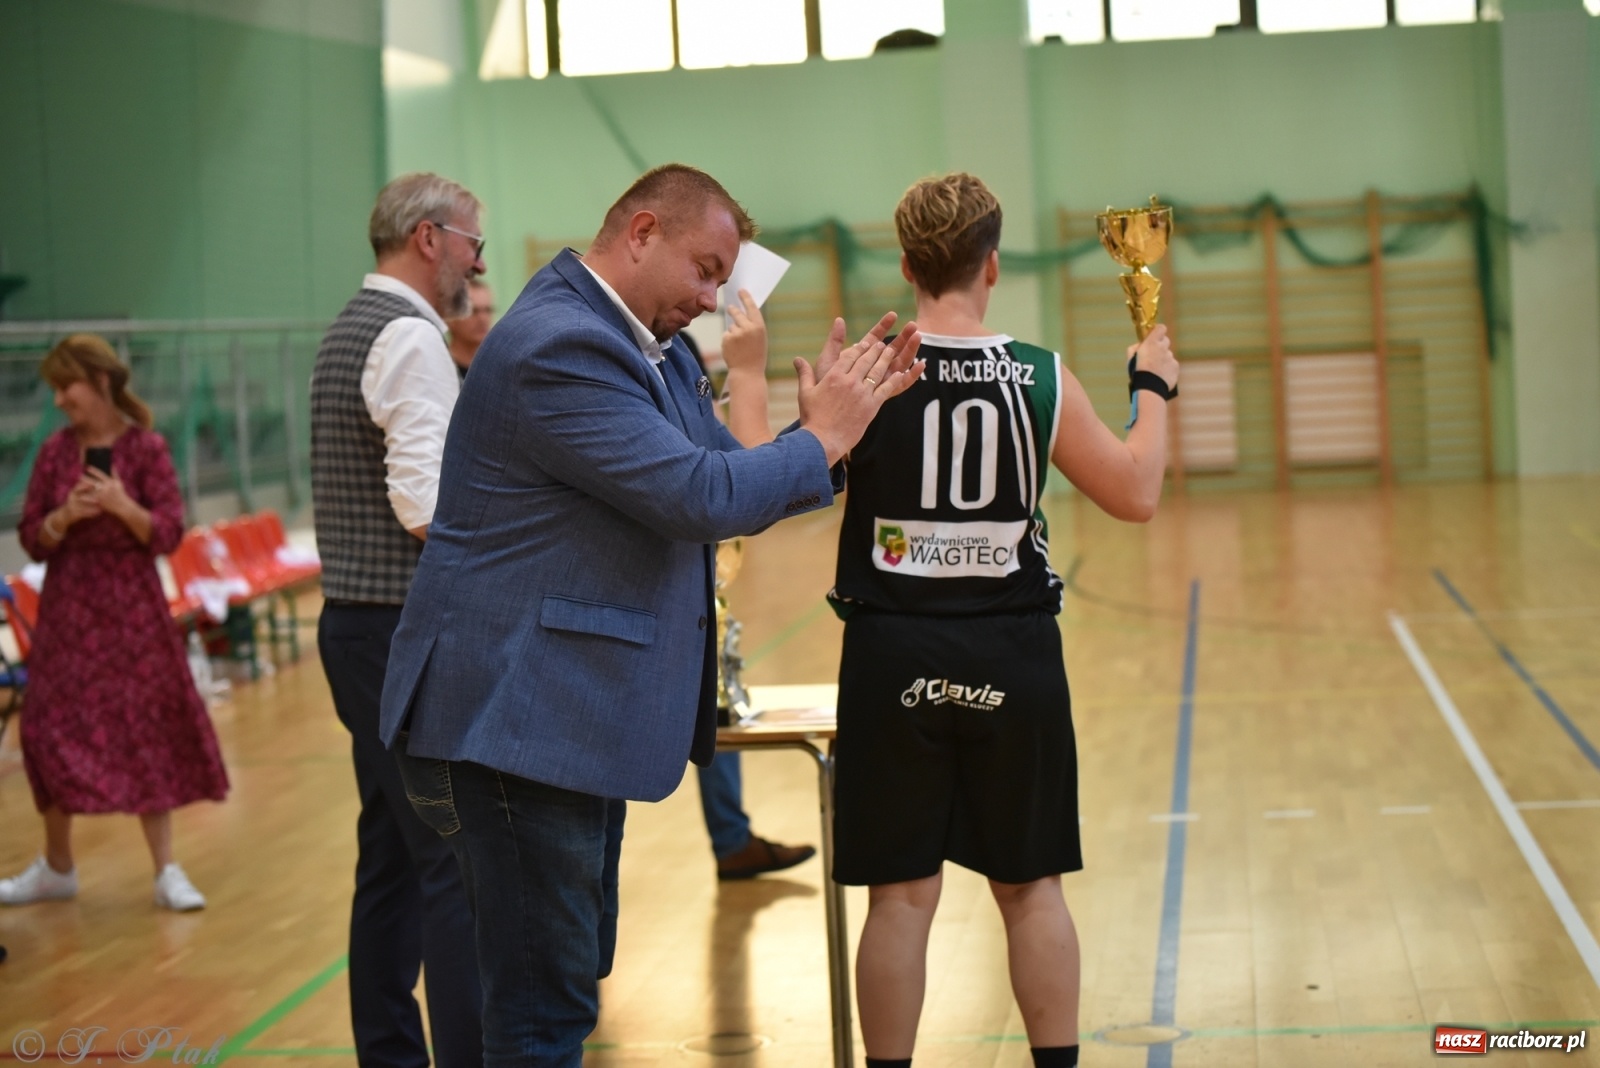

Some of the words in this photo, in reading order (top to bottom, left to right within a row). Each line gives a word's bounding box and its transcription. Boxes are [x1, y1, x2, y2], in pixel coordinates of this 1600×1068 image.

[938, 353, 1036, 386] RACIBÓRZ
[920, 398, 999, 510] 10
[910, 533, 989, 547] wydawnictwo
[926, 679, 1006, 706] Clavis
